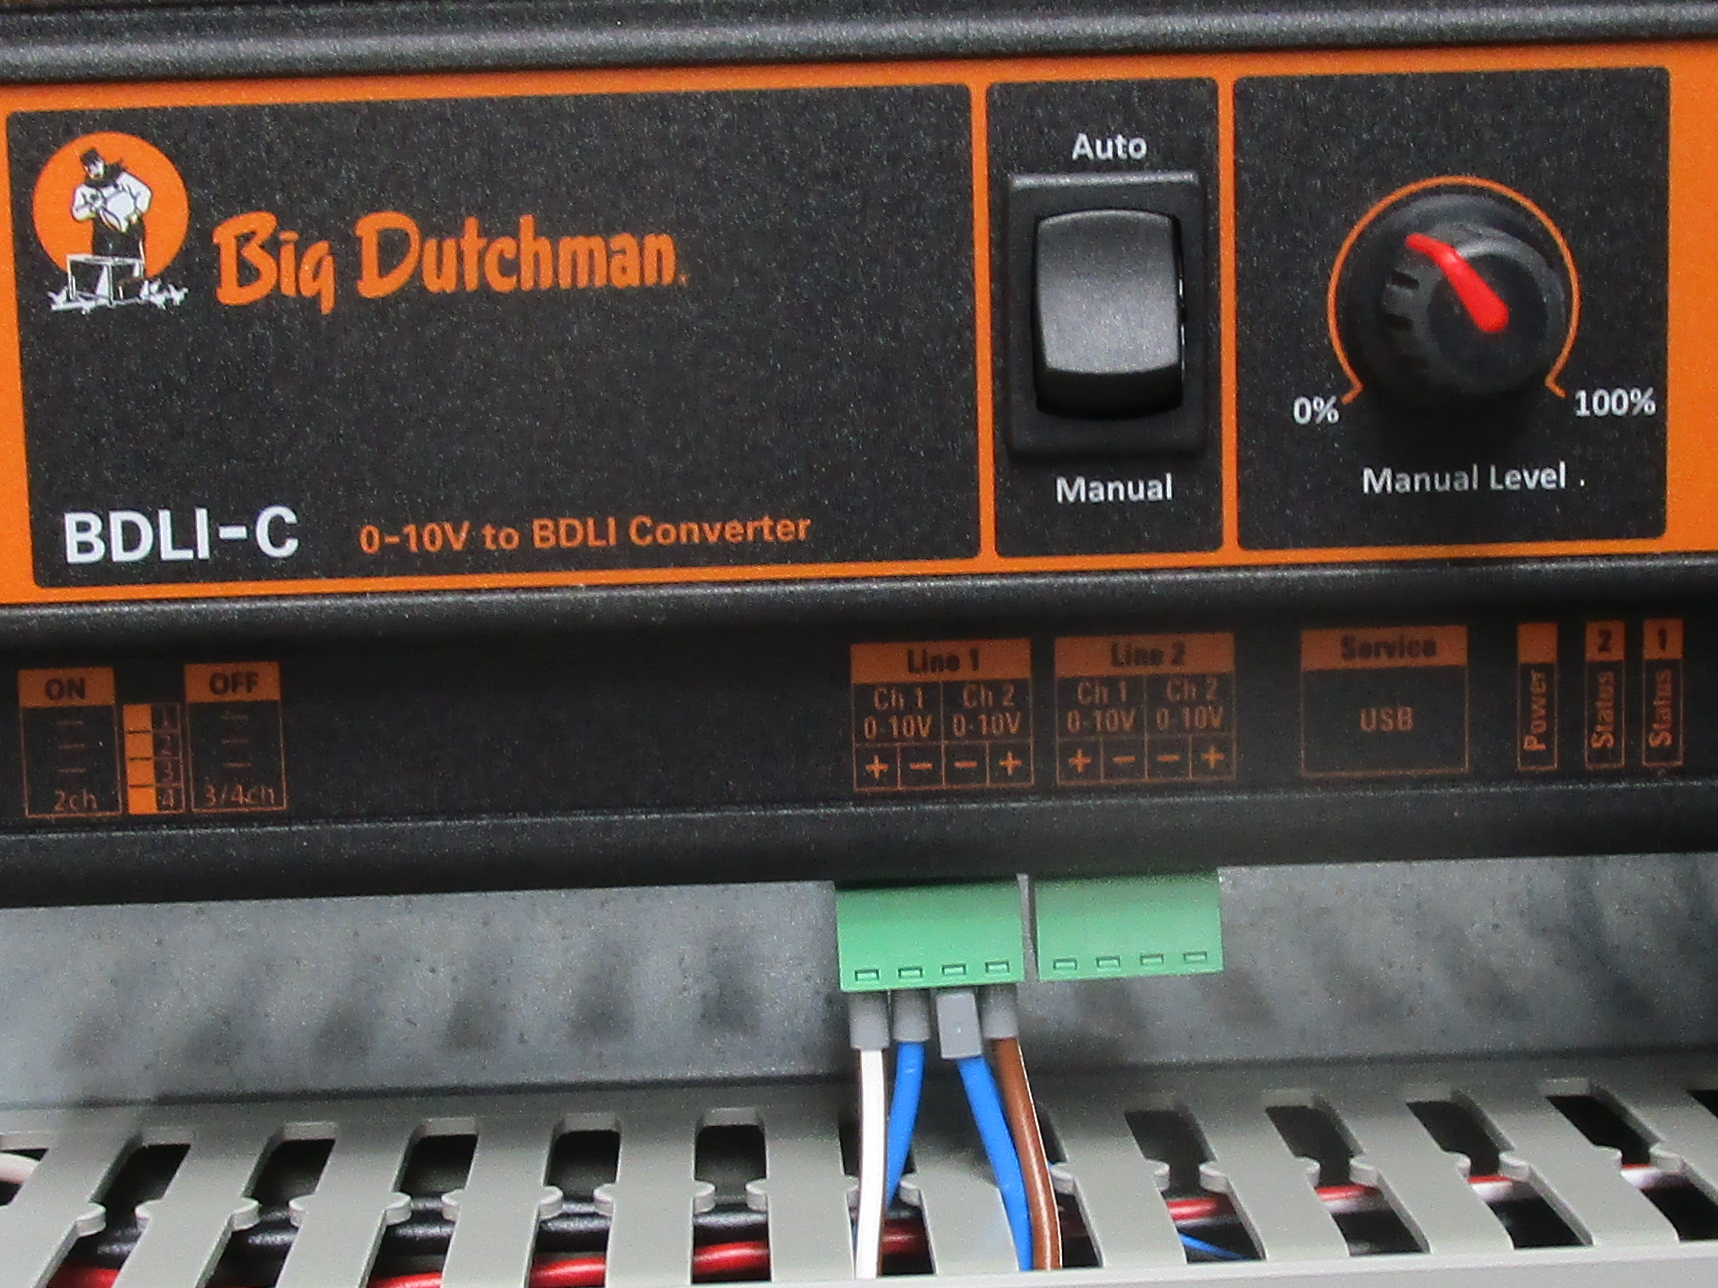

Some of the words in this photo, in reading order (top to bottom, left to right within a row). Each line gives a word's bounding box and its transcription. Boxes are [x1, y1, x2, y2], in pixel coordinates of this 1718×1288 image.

[1072, 133, 1148, 161] Auto
[213, 209, 336, 314] Big
[354, 211, 678, 300] Dutchman
[1293, 396, 1340, 425] 0%
[1574, 387, 1656, 418] 100%
[1055, 474, 1173, 505] Manual
[1363, 464, 1480, 495] Manual
[1490, 461, 1567, 492] Level
[65, 504, 299, 566] BDLI-C
[359, 520, 470, 555] 0-10V
[483, 521, 520, 551] to
[531, 517, 617, 549] BDLI
[629, 513, 811, 547] Converter
[907, 648, 960, 674] Line
[969, 648, 981, 670] 1
[1110, 643, 1163, 668] Line
[1174, 642, 1187, 665] 2
[1341, 635, 1436, 661] Service
[44, 678, 86, 701] ON
[209, 672, 259, 695] OFF
[1360, 706, 1415, 732] USB
